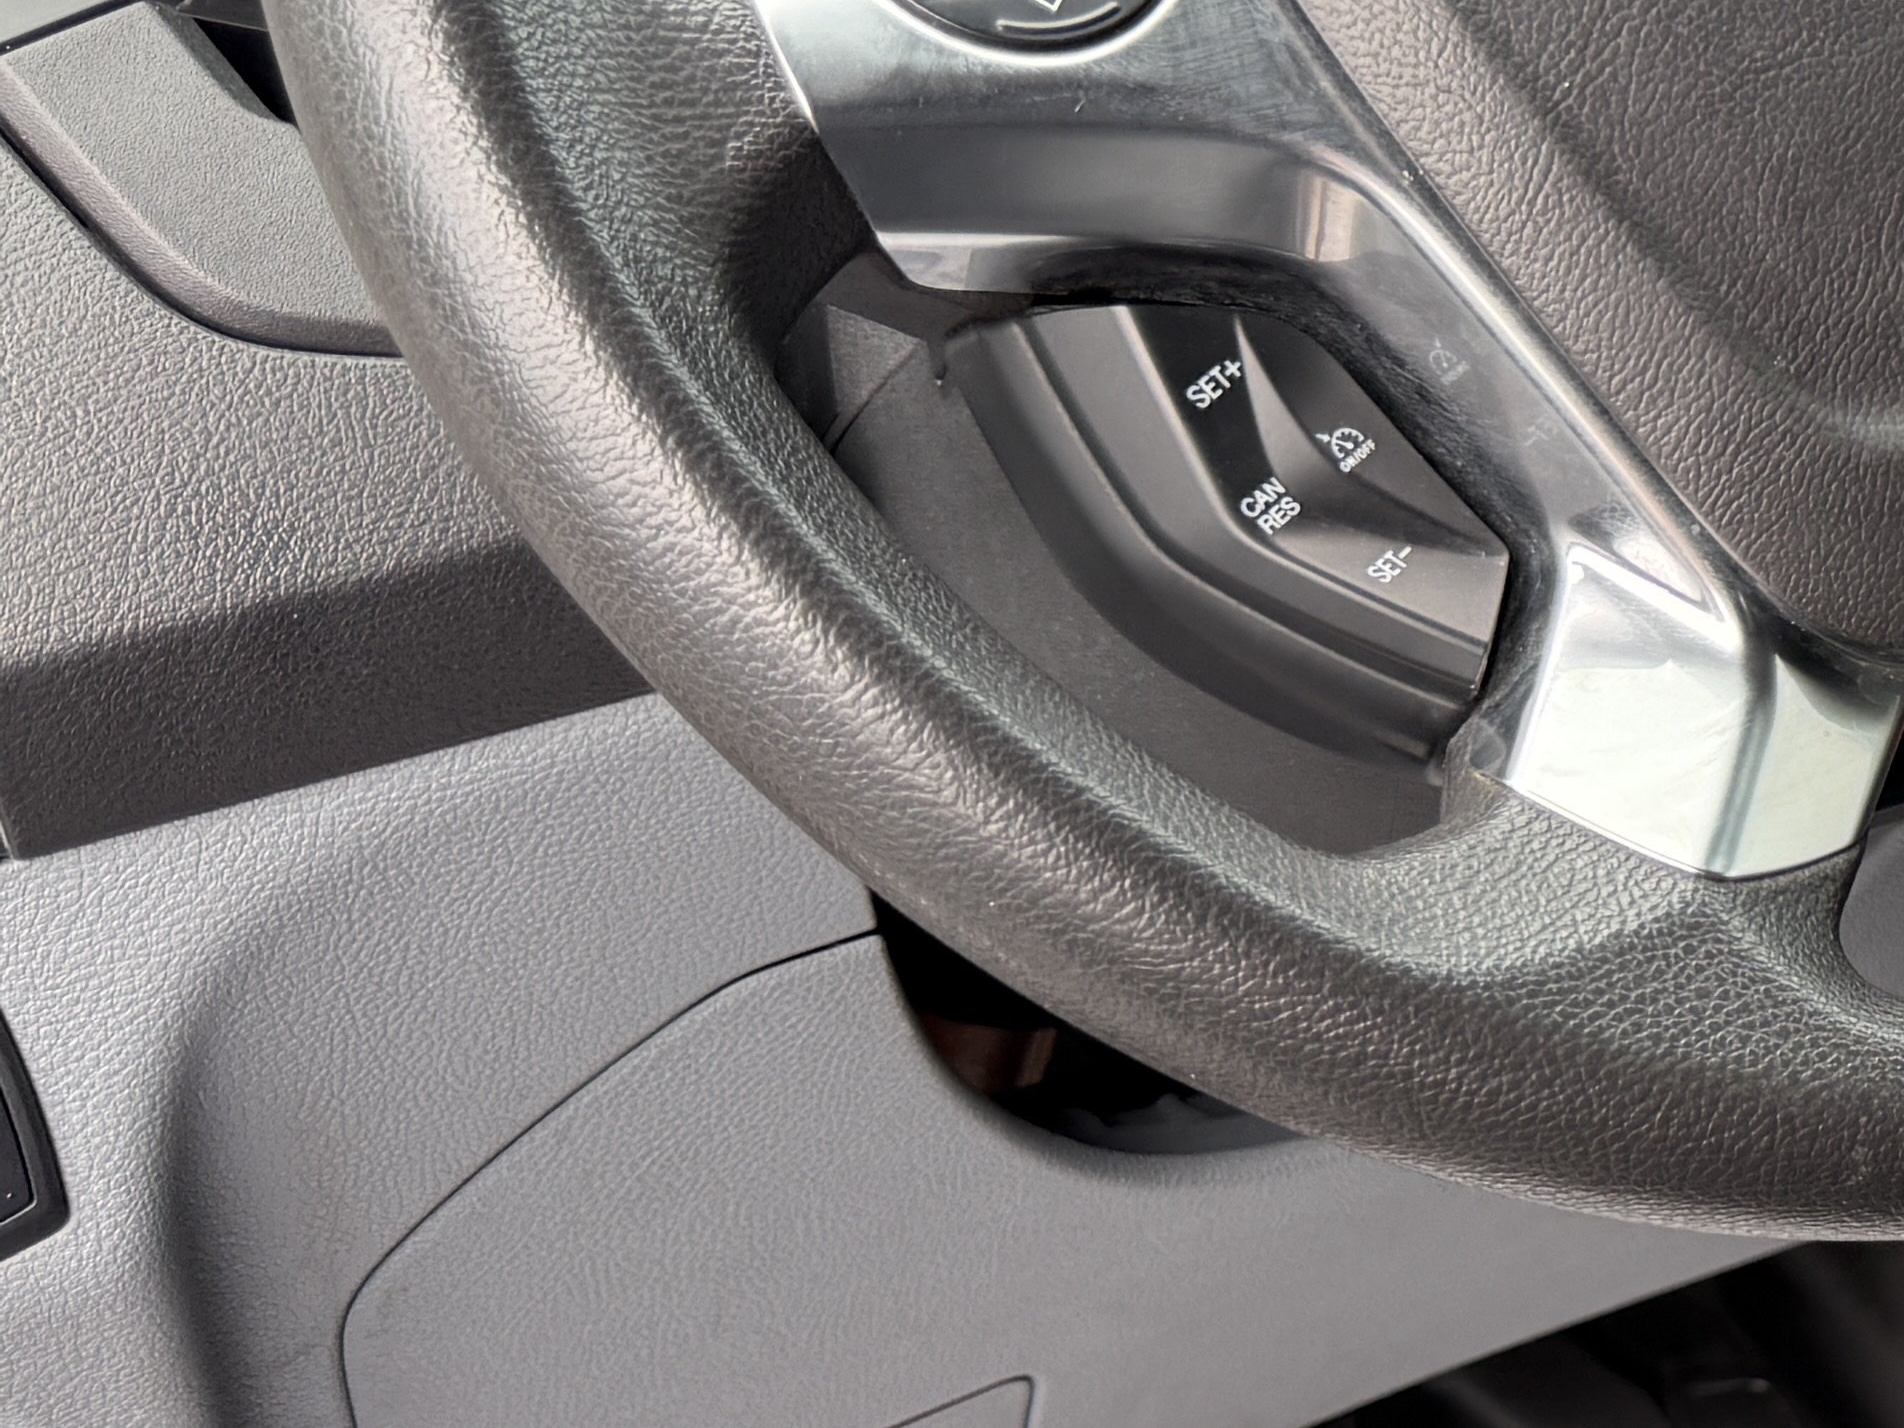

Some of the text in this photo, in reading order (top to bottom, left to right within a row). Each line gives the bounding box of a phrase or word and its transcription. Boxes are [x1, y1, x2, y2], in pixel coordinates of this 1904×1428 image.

[1186, 357, 1242, 410] SET+
[1339, 438, 1376, 472] ON/OFF
[1239, 476, 1288, 519] CAN
[1256, 496, 1301, 536] RES
